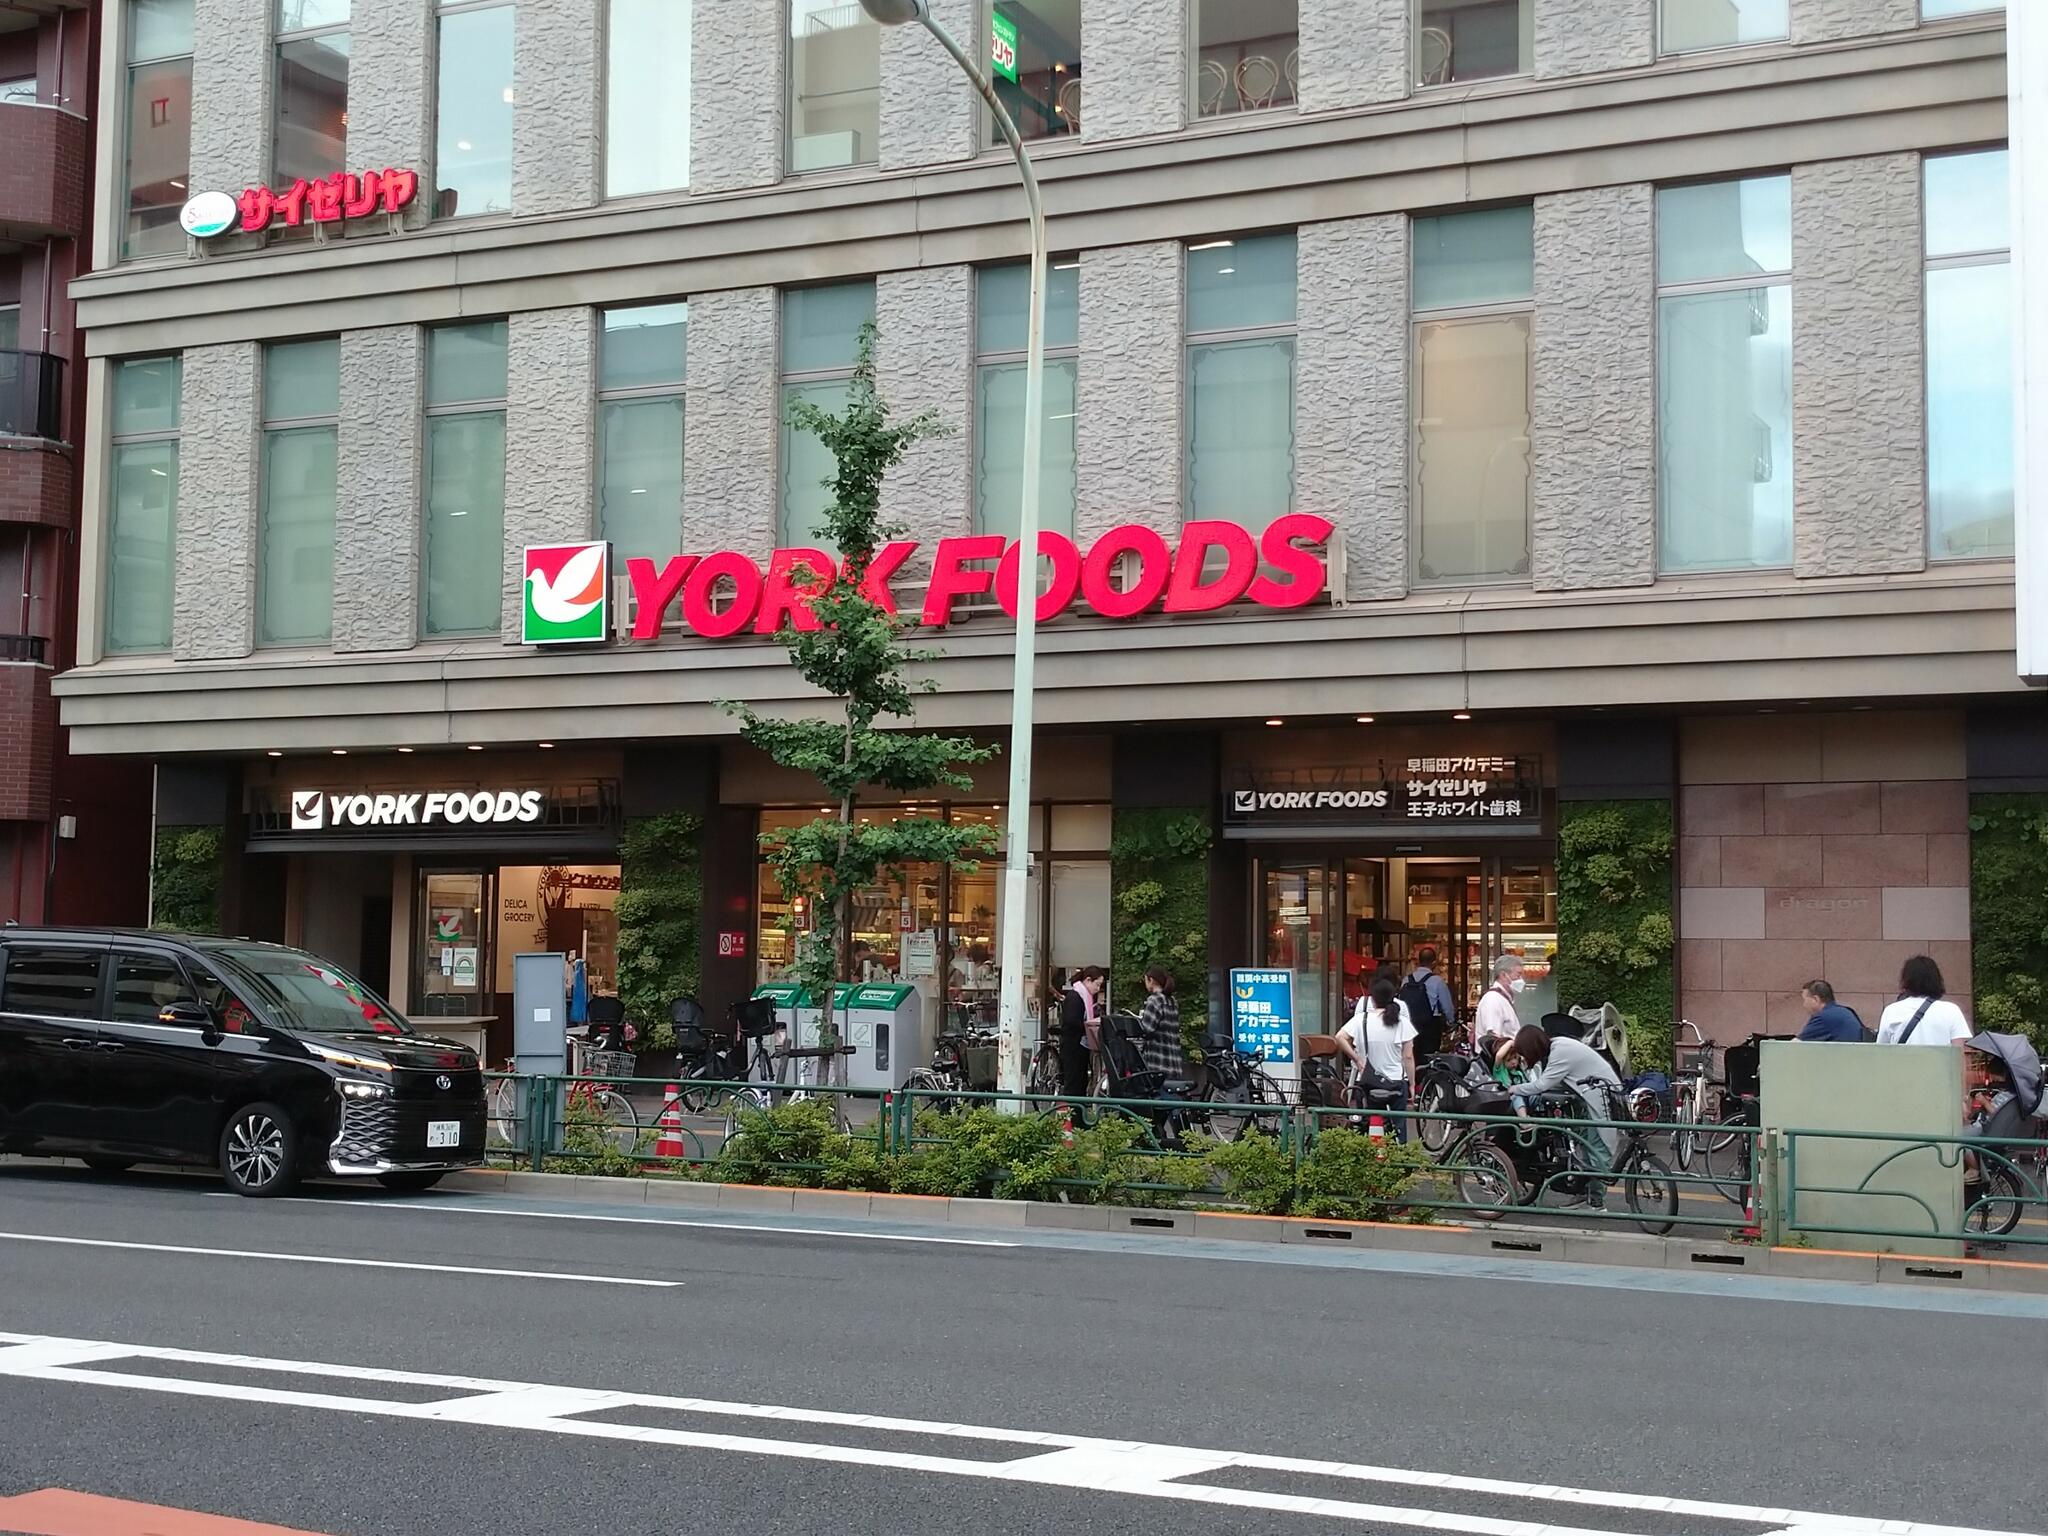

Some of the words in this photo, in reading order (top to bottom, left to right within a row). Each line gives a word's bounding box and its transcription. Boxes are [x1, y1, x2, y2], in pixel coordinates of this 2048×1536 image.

[238, 168, 418, 232] サイゼリヤ
[921, 513, 1336, 627] FOODS
[1407, 757, 1516, 773] 早稲田アカデミー
[1406, 779, 1487, 797] サイゼリヤ
[330, 793, 422, 826] YORK
[422, 790, 542, 824] FOODS
[1258, 791, 1315, 809] YORK
[1315, 790, 1388, 808] FOODS
[1407, 800, 1521, 818] 王子ホワイト歯科
[504, 898, 528, 909] DELICA
[504, 912, 536, 922] GROCERY
[902, 917, 909, 927] 5
[1236, 1014, 1290, 1028] アカデミー
